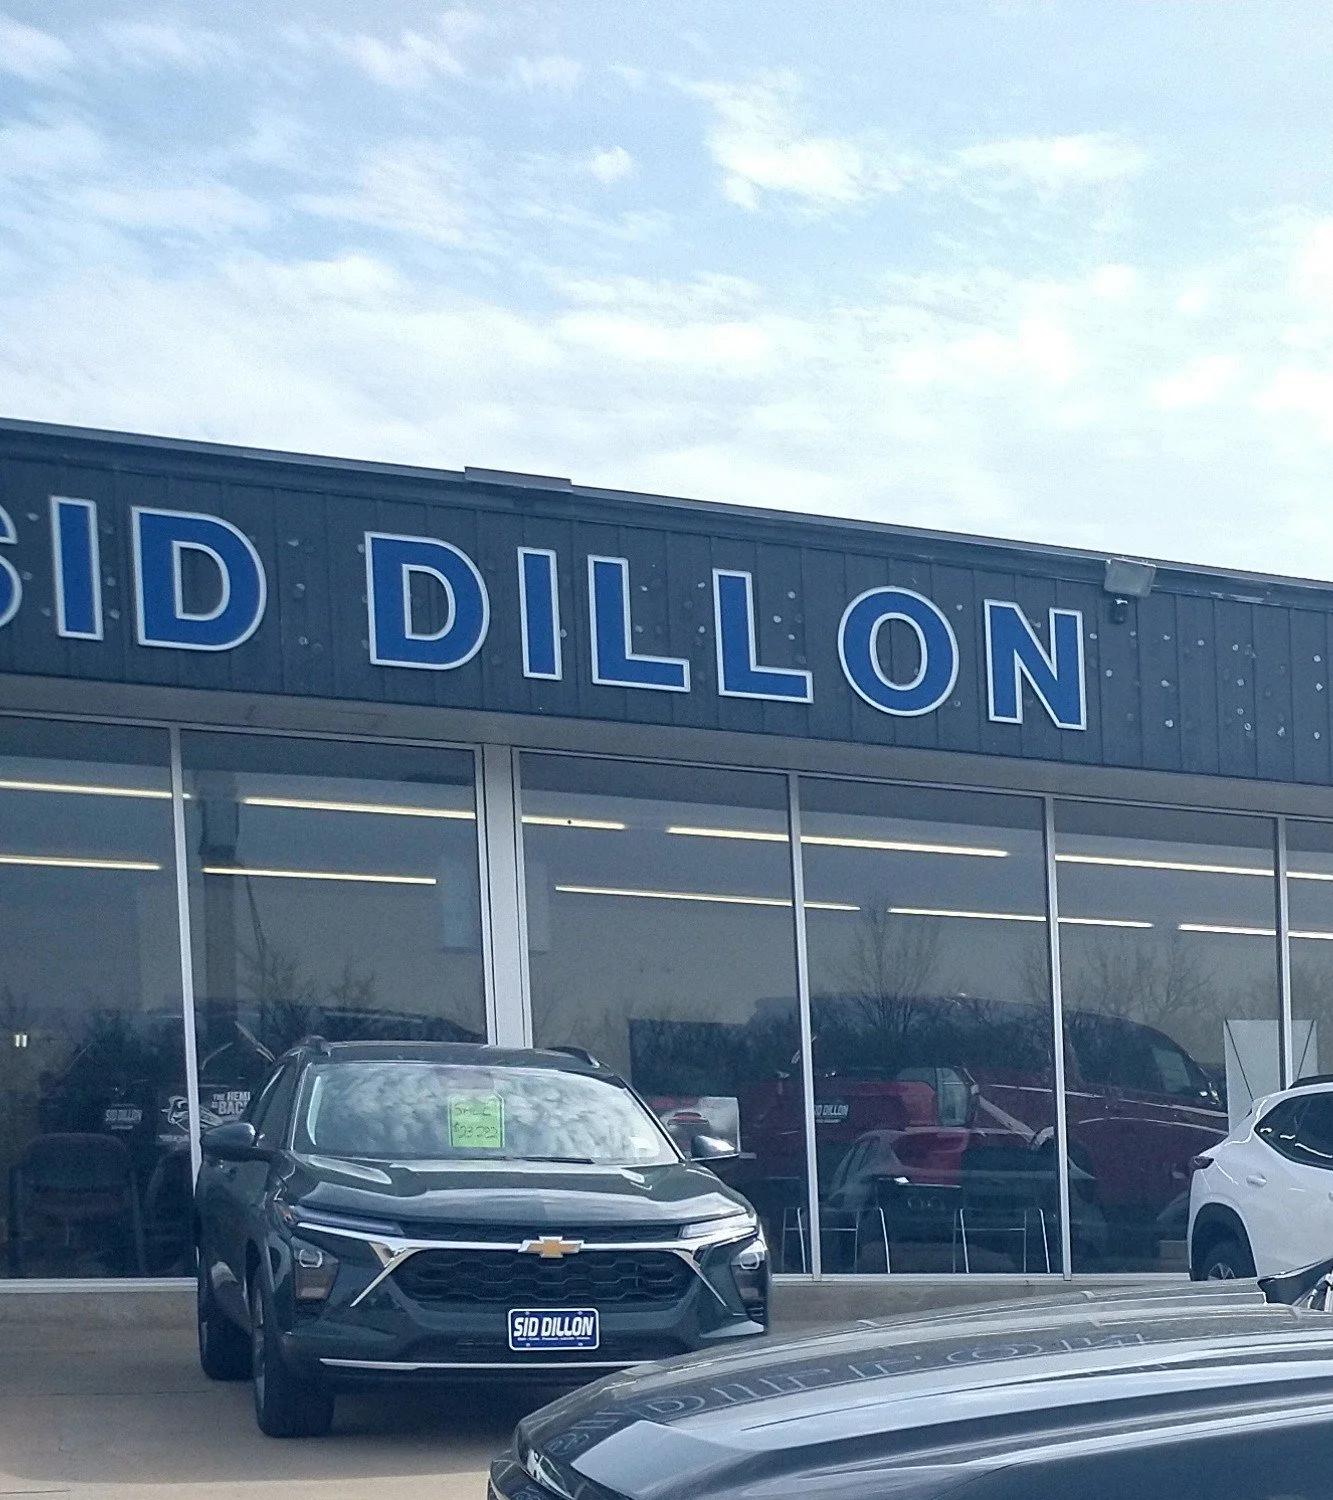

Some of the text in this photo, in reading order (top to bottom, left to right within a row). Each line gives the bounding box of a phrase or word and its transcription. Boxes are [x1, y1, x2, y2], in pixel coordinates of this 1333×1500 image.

[0, 496, 1088, 731] ID DILLON
[227, 1091, 251, 1101] HEMI
[513, 1316, 595, 1337] SID DILLON
